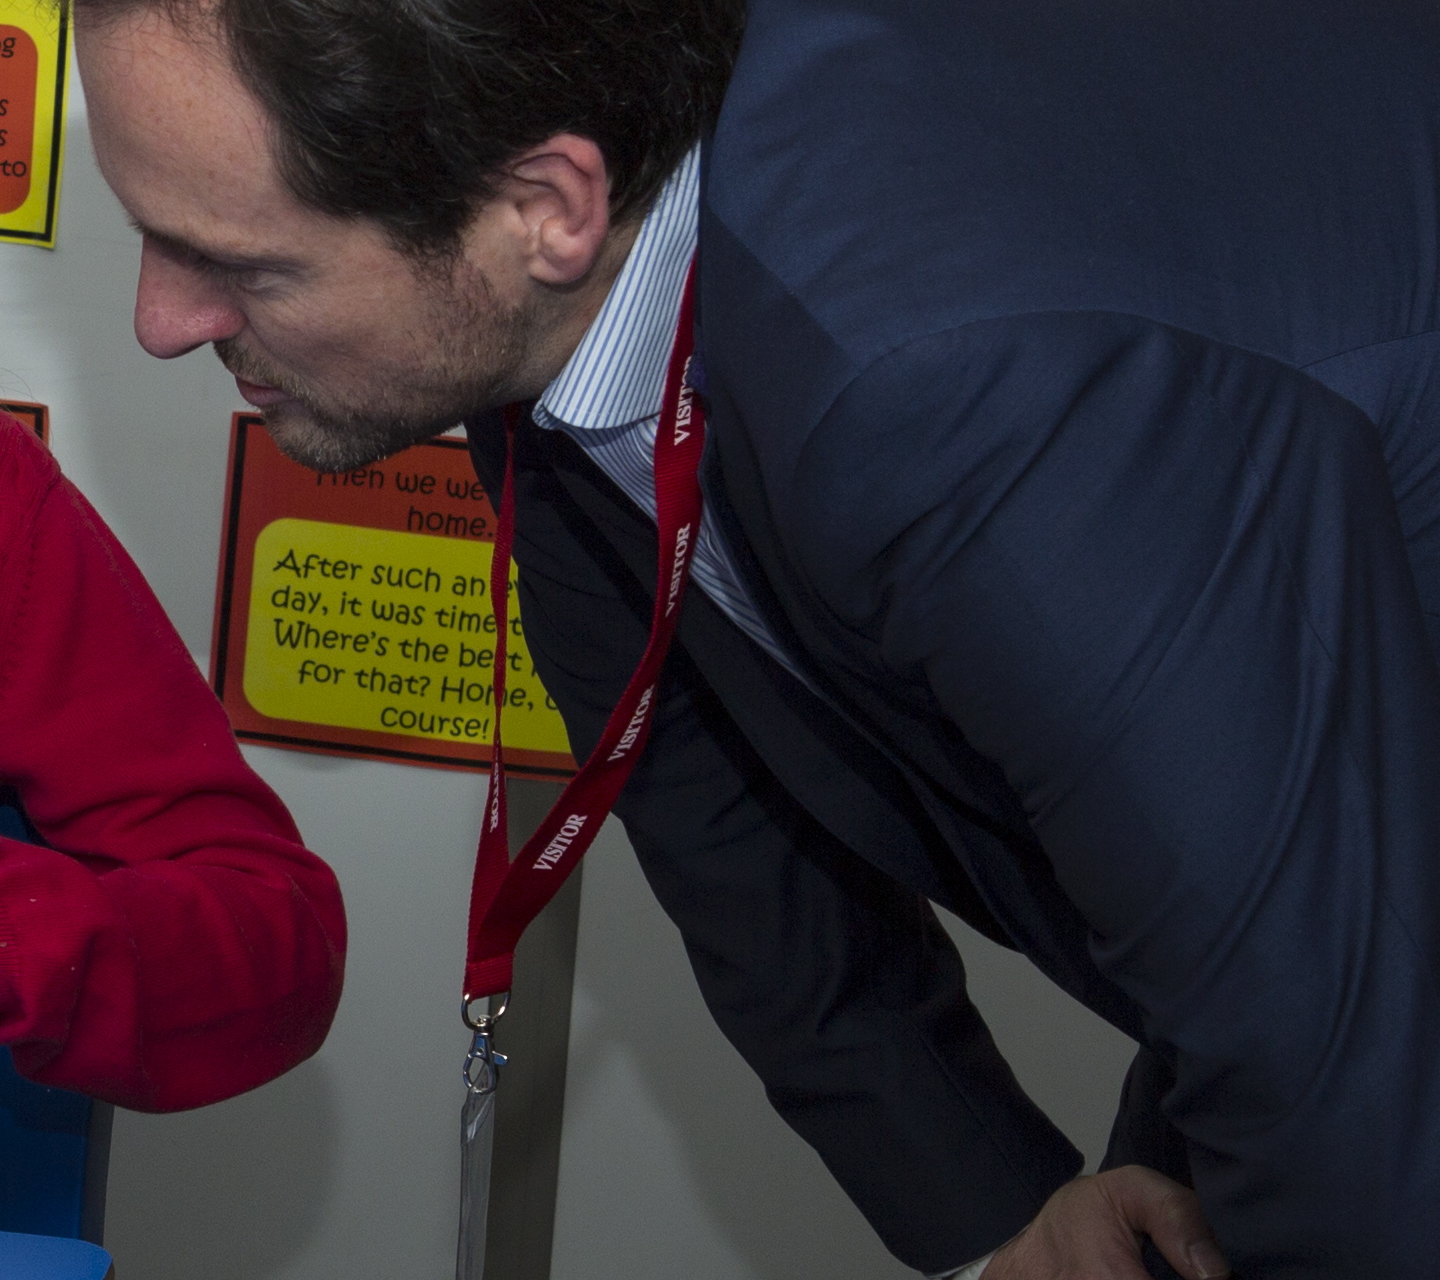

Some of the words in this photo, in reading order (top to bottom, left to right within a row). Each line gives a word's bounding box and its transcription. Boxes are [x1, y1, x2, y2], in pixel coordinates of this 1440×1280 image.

[0, 159, 26, 177] to
[395, 472, 436, 494] we
[406, 506, 494, 538] home.
[273, 549, 363, 581] After
[370, 564, 441, 593] such
[451, 575, 486, 597] an
[665, 523, 690, 617] VISITOR
[271, 585, 328, 616] day,
[339, 591, 362, 617] it
[371, 599, 426, 626] was
[434, 605, 496, 634] time
[398, 637, 449, 663] the
[459, 644, 522, 671] bet
[298, 659, 346, 685] for
[354, 666, 431, 698] that?
[380, 706, 490, 738] course!
[608, 685, 654, 763] VISITOR
[533, 813, 588, 873] VISITOR
